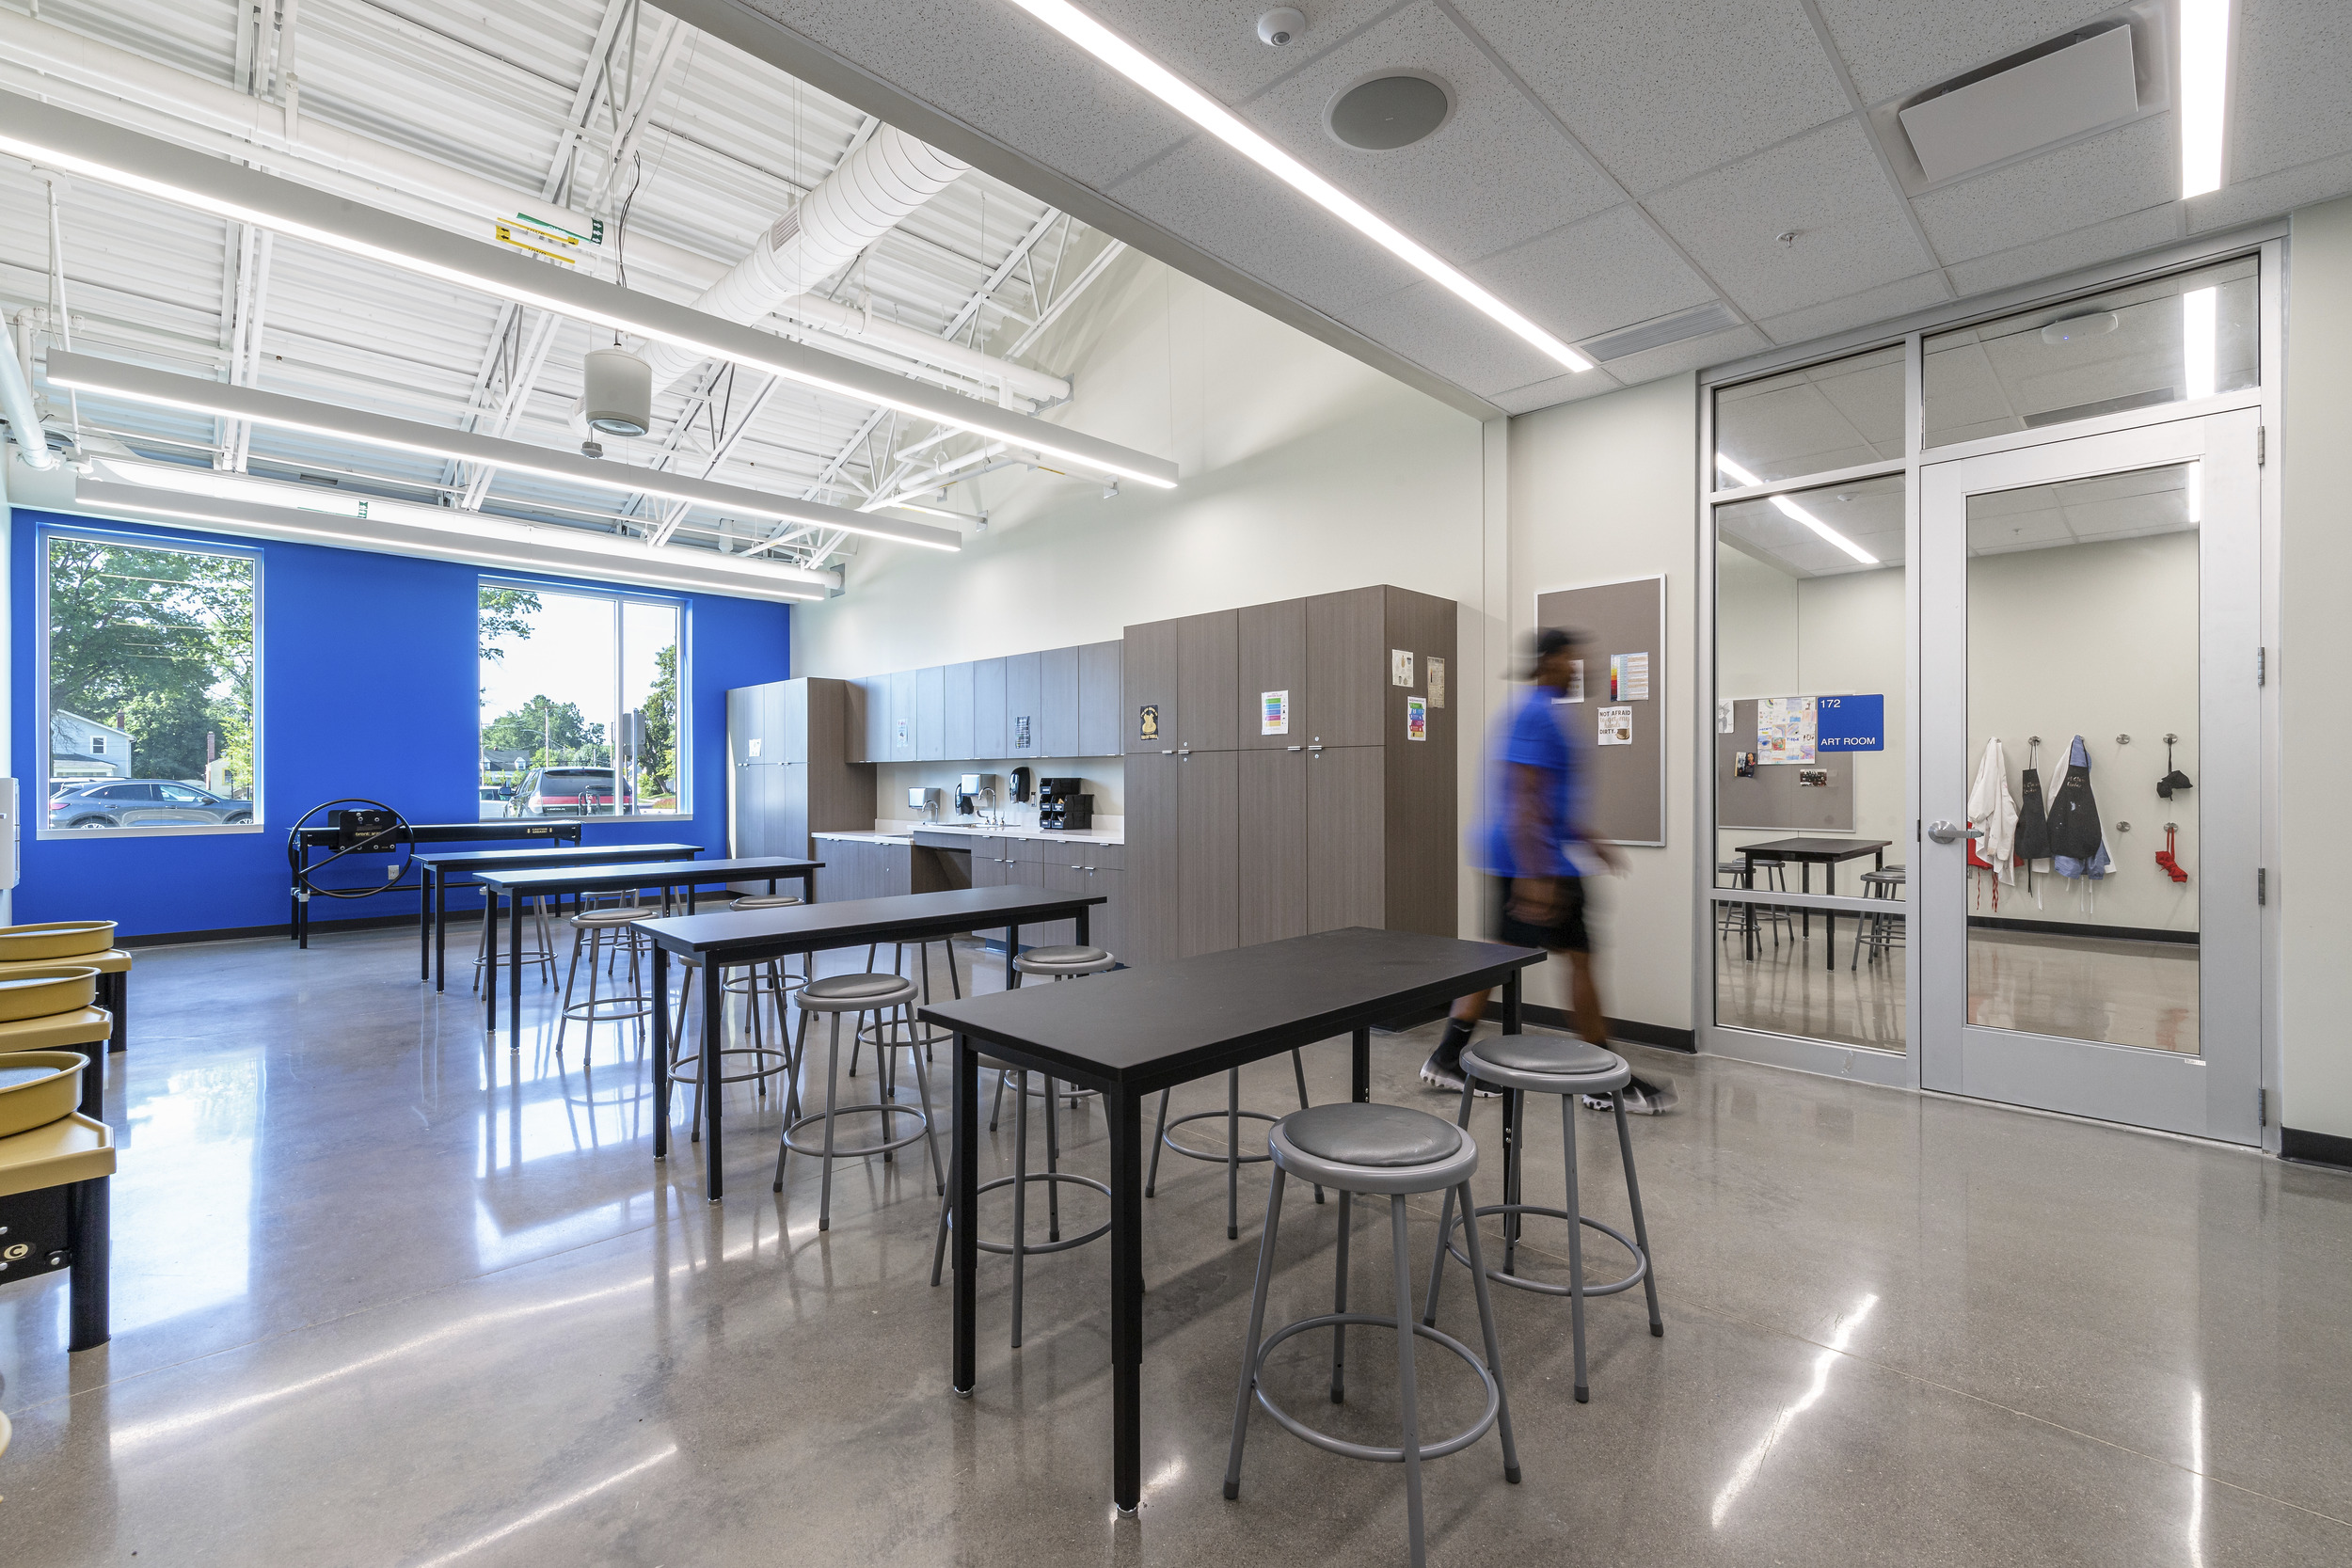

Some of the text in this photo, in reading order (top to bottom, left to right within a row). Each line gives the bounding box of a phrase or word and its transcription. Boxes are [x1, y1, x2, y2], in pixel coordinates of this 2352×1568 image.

[1820, 699, 1841, 708] 172
[1820, 736, 1876, 746] ART ROOM
